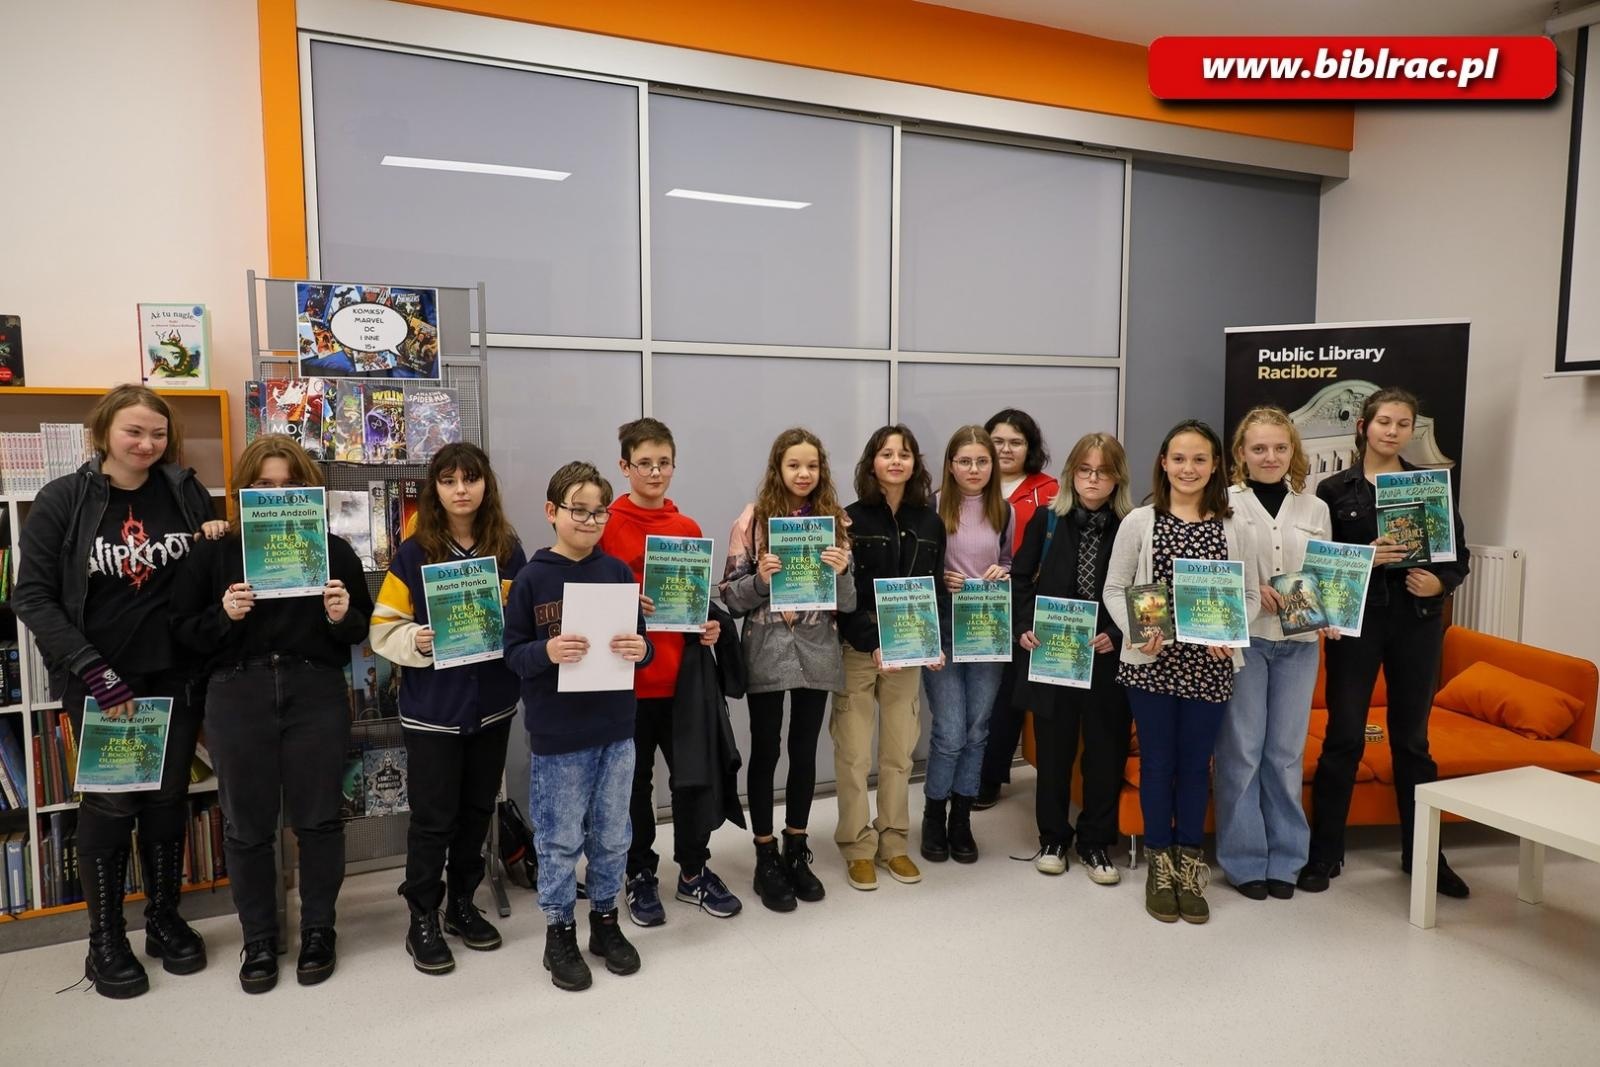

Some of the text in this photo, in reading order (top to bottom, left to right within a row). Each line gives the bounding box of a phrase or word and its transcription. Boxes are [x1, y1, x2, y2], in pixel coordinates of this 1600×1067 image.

[1258, 346, 1385, 363] Public Library
[1258, 365, 1338, 380] Raciborz
[1390, 476, 1434, 486] DYPLOM
[258, 494, 309, 505] DYPLOM
[280, 509, 317, 517] Andzolin
[782, 523, 822, 532] DYPLOM
[660, 542, 700, 552] DYPLOM
[1320, 545, 1361, 558] DYPLOM
[438, 565, 482, 578] DYPLOM
[1188, 564, 1232, 574] DYPLOM
[436, 584, 459, 592] Marta
[1048, 602, 1085, 614] DYPLOM
